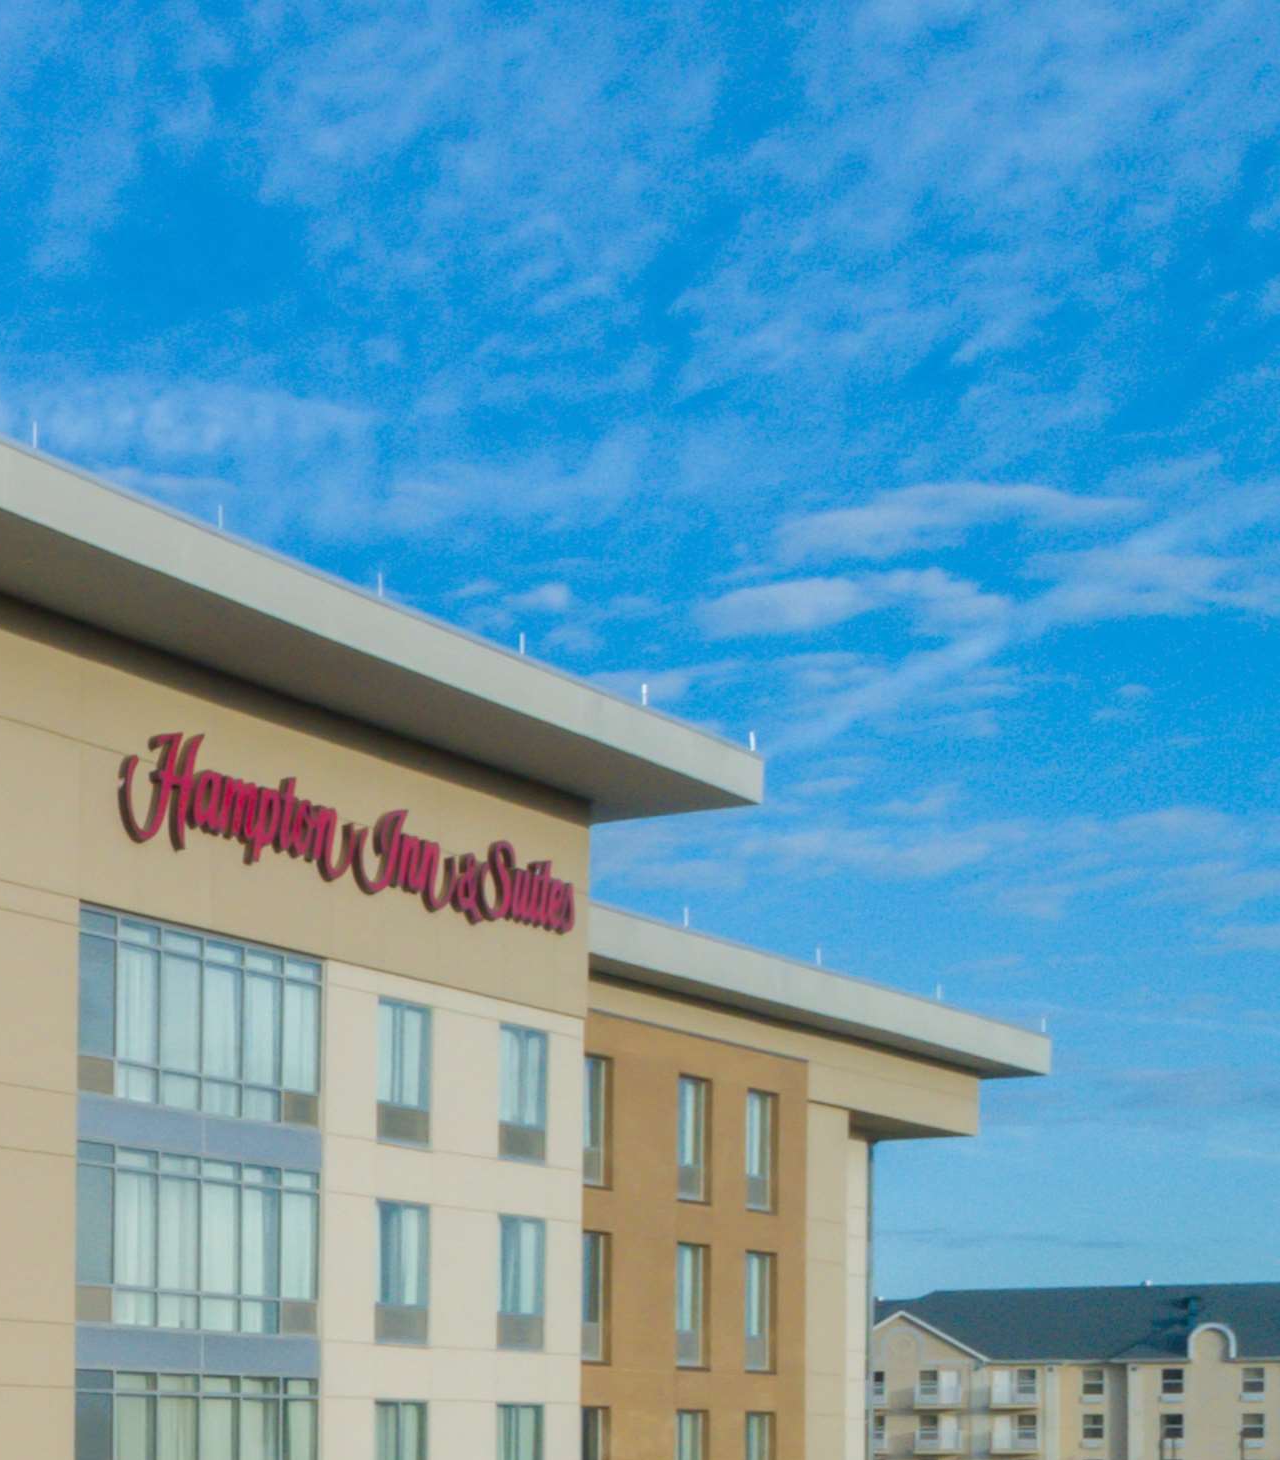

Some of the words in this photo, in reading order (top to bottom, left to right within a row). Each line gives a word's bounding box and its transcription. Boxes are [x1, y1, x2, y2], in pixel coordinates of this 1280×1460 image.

[118, 732, 355, 882] Hampton
[352, 809, 455, 912] Inn
[449, 853, 482, 925] &
[478, 840, 575, 935] Suites
